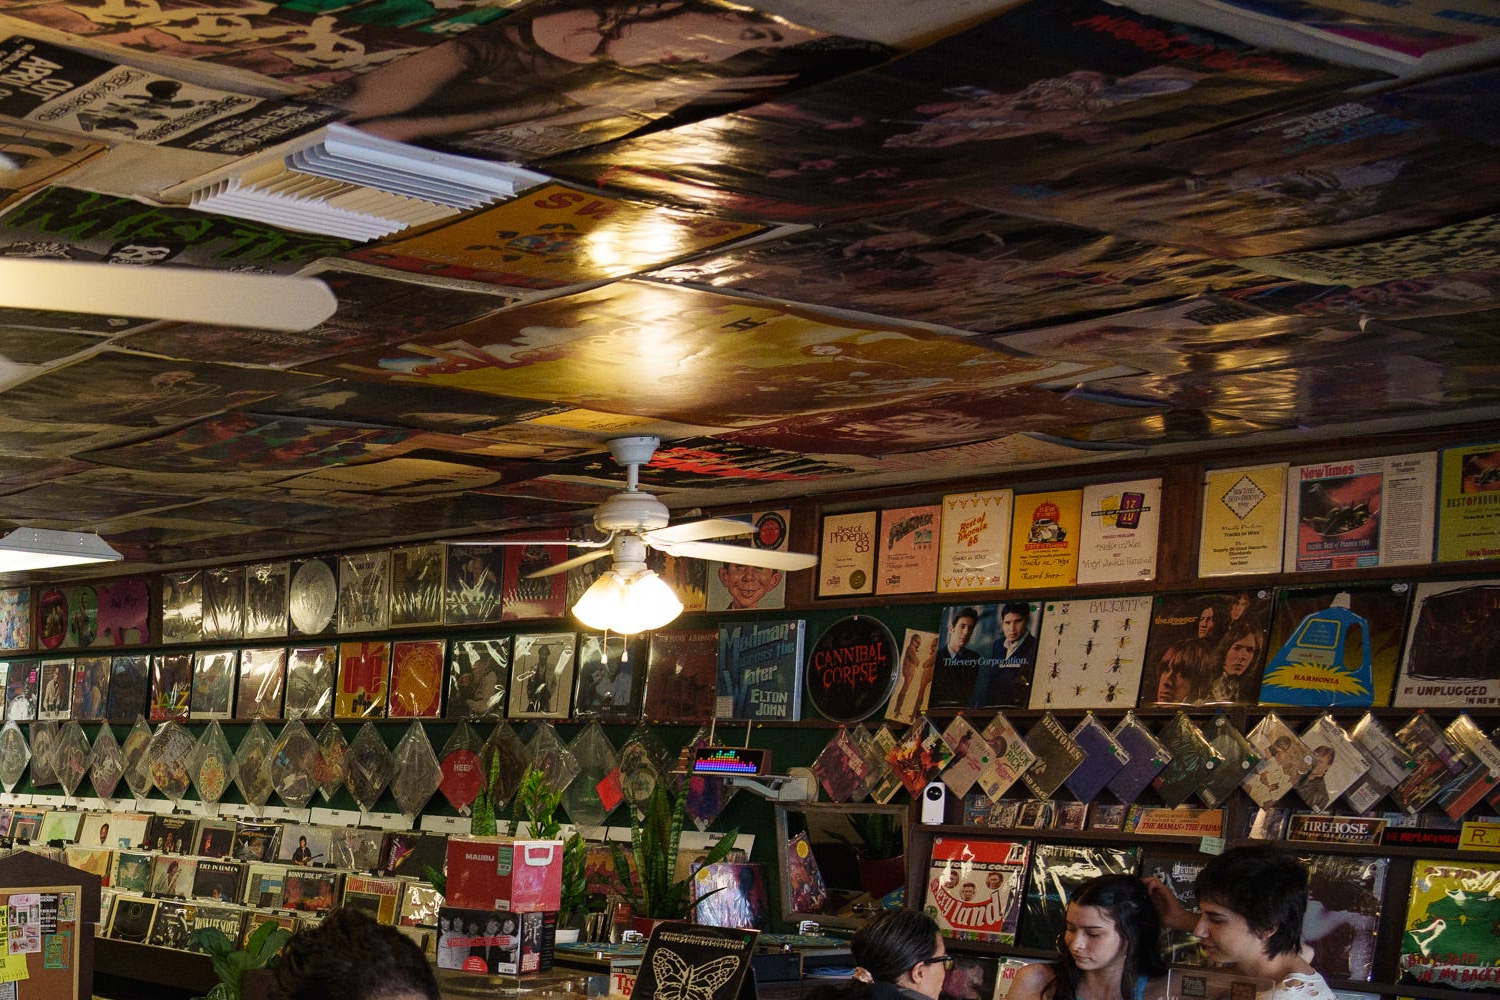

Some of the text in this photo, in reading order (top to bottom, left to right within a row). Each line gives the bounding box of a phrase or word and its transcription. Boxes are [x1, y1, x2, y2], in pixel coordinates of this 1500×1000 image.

[838, 525, 852, 535] Best
[957, 521, 989, 544] Phoenix
[829, 530, 869, 544] Phoenix
[855, 541, 870, 554] 83
[1089, 599, 1142, 615] BARRETT
[814, 641, 887, 671] CANNIBAL
[943, 656, 978, 668] Thievery
[822, 662, 879, 690] CORPSE
[1293, 674, 1340, 687] HARMONIA
[750, 689, 789, 704] ELTON
[1417, 685, 1488, 698] UNPLUGGED
[1475, 696, 1495, 706] NEW
[755, 703, 788, 717] JOHN
[1010, 740, 1032, 765] SLICK
[1004, 751, 1025, 772] RICK
[1143, 821, 1222, 832] THE MAMAS THE PAPAS
[1304, 821, 1369, 834] fIREHOSE
[465, 853, 496, 862] MALIBU
[288, 870, 304, 878] SONNY
[304, 871, 314, 879] SIDE
[1439, 968, 1460, 983] MY
